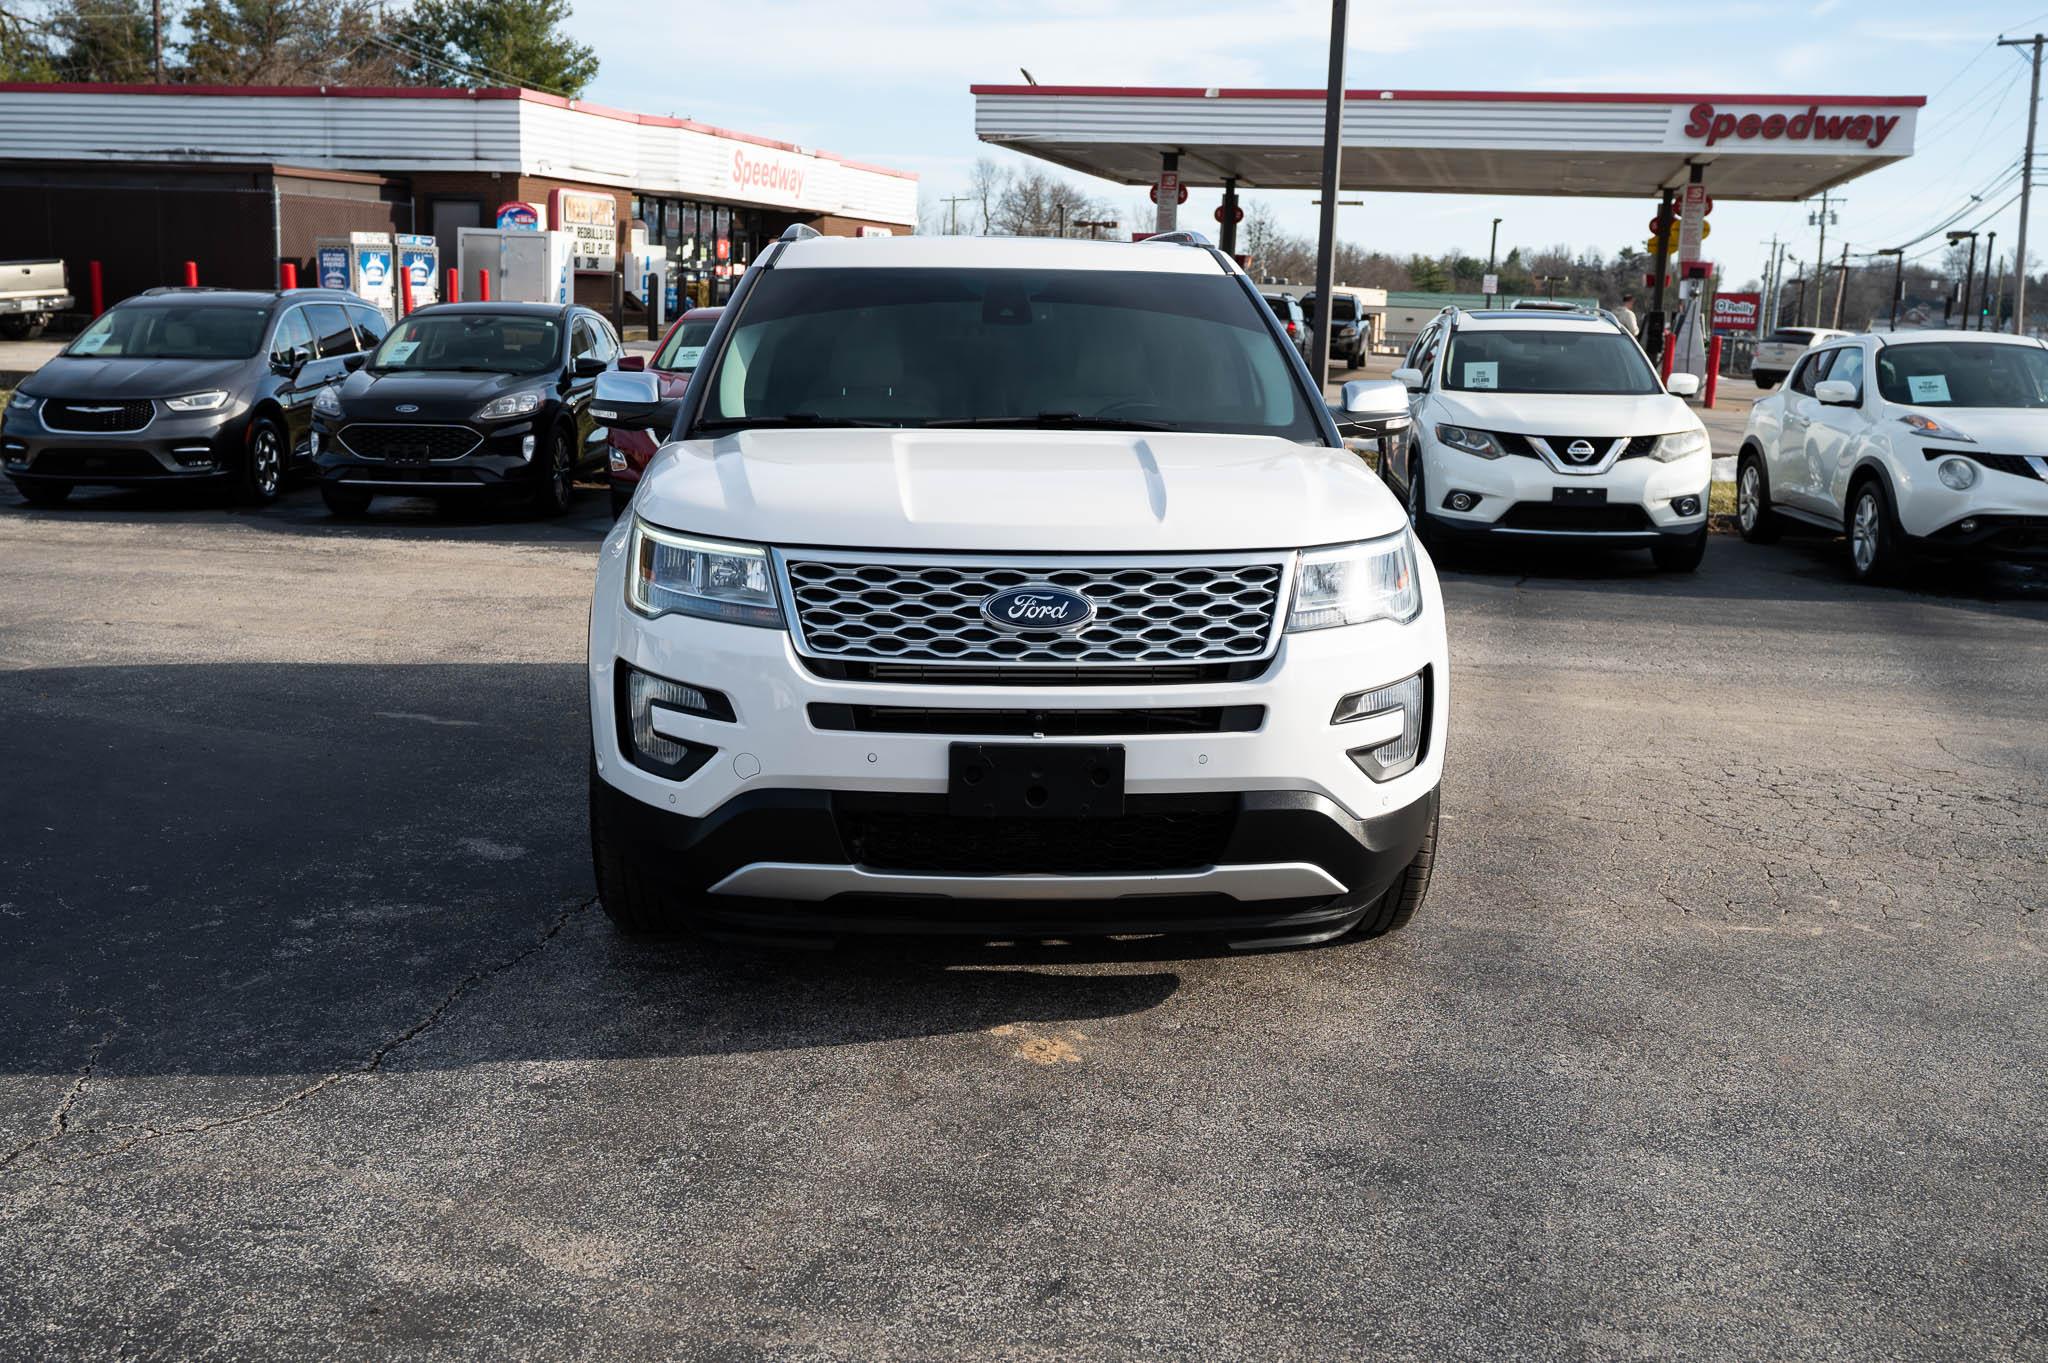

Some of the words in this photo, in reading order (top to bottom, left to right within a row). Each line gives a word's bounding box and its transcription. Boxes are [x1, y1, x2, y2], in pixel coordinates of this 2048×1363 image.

[1684, 103, 1901, 149] Speedway
[732, 149, 805, 199] Speedway
[1713, 315, 1732, 323] AUTO
[1733, 316, 1756, 324] PARTS
[1007, 594, 1071, 619] Ford
